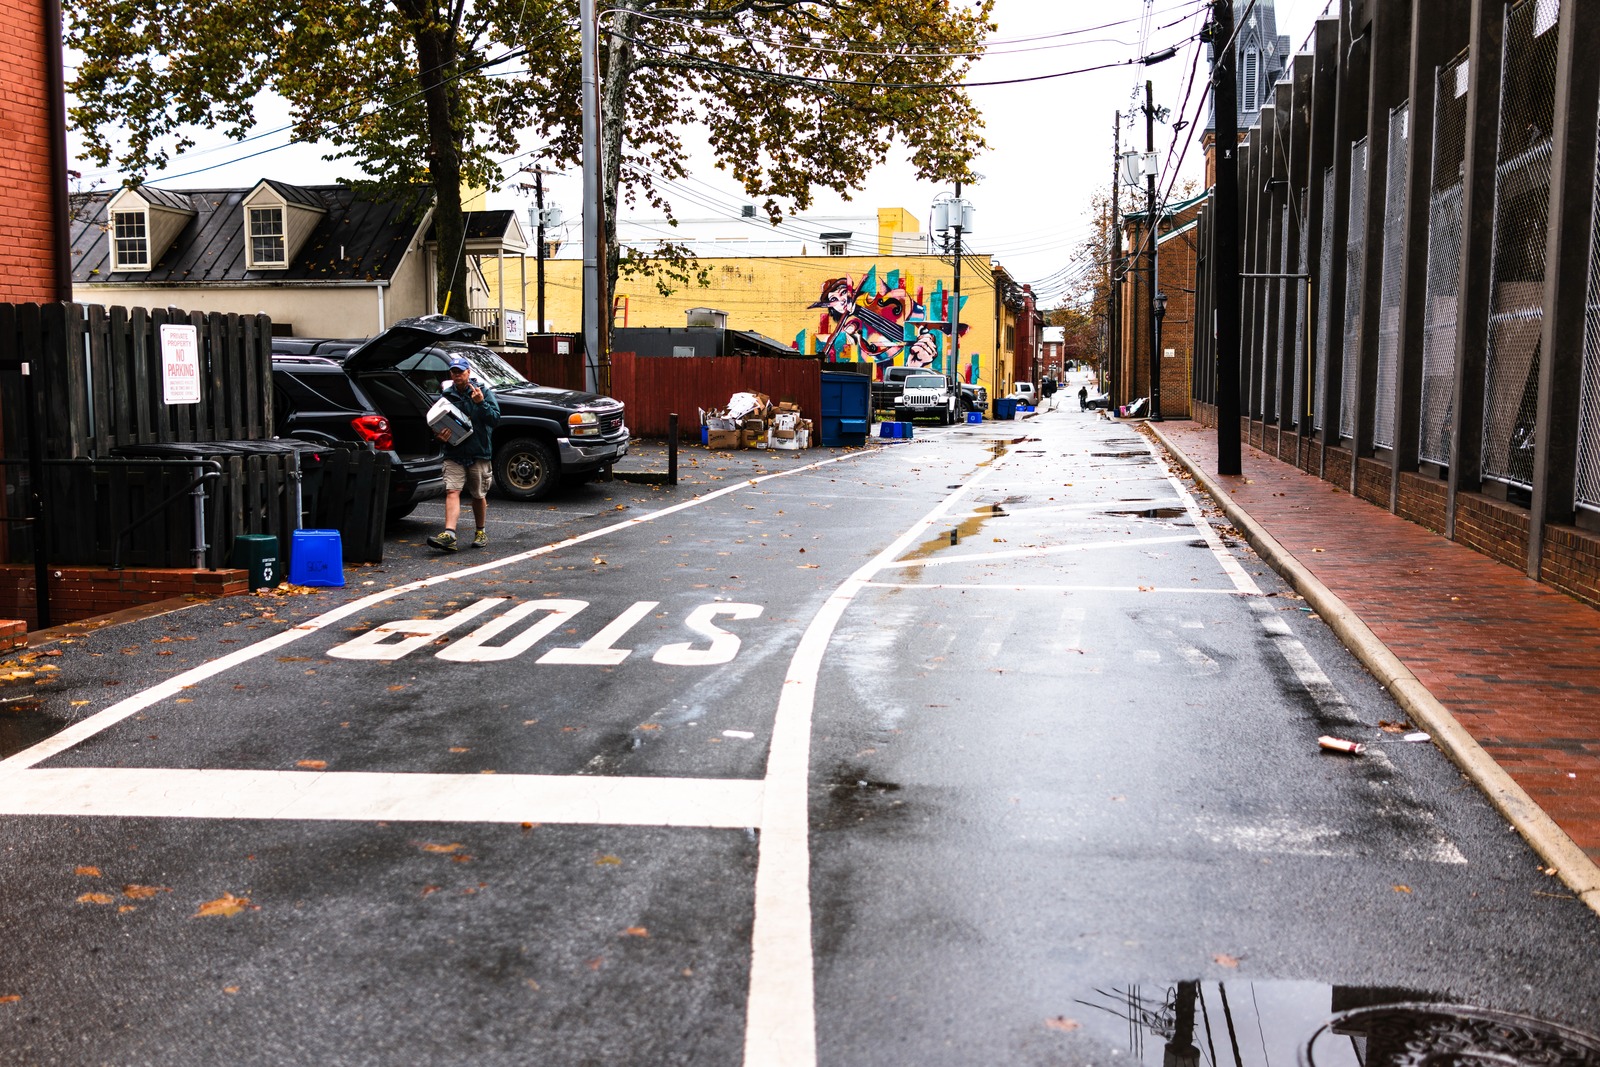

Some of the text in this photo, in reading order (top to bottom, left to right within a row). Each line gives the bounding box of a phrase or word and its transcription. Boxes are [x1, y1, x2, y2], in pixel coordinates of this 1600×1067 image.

[176, 349, 184, 362] NO
[168, 364, 194, 376] PARKING
[326, 598, 764, 666] STOP
